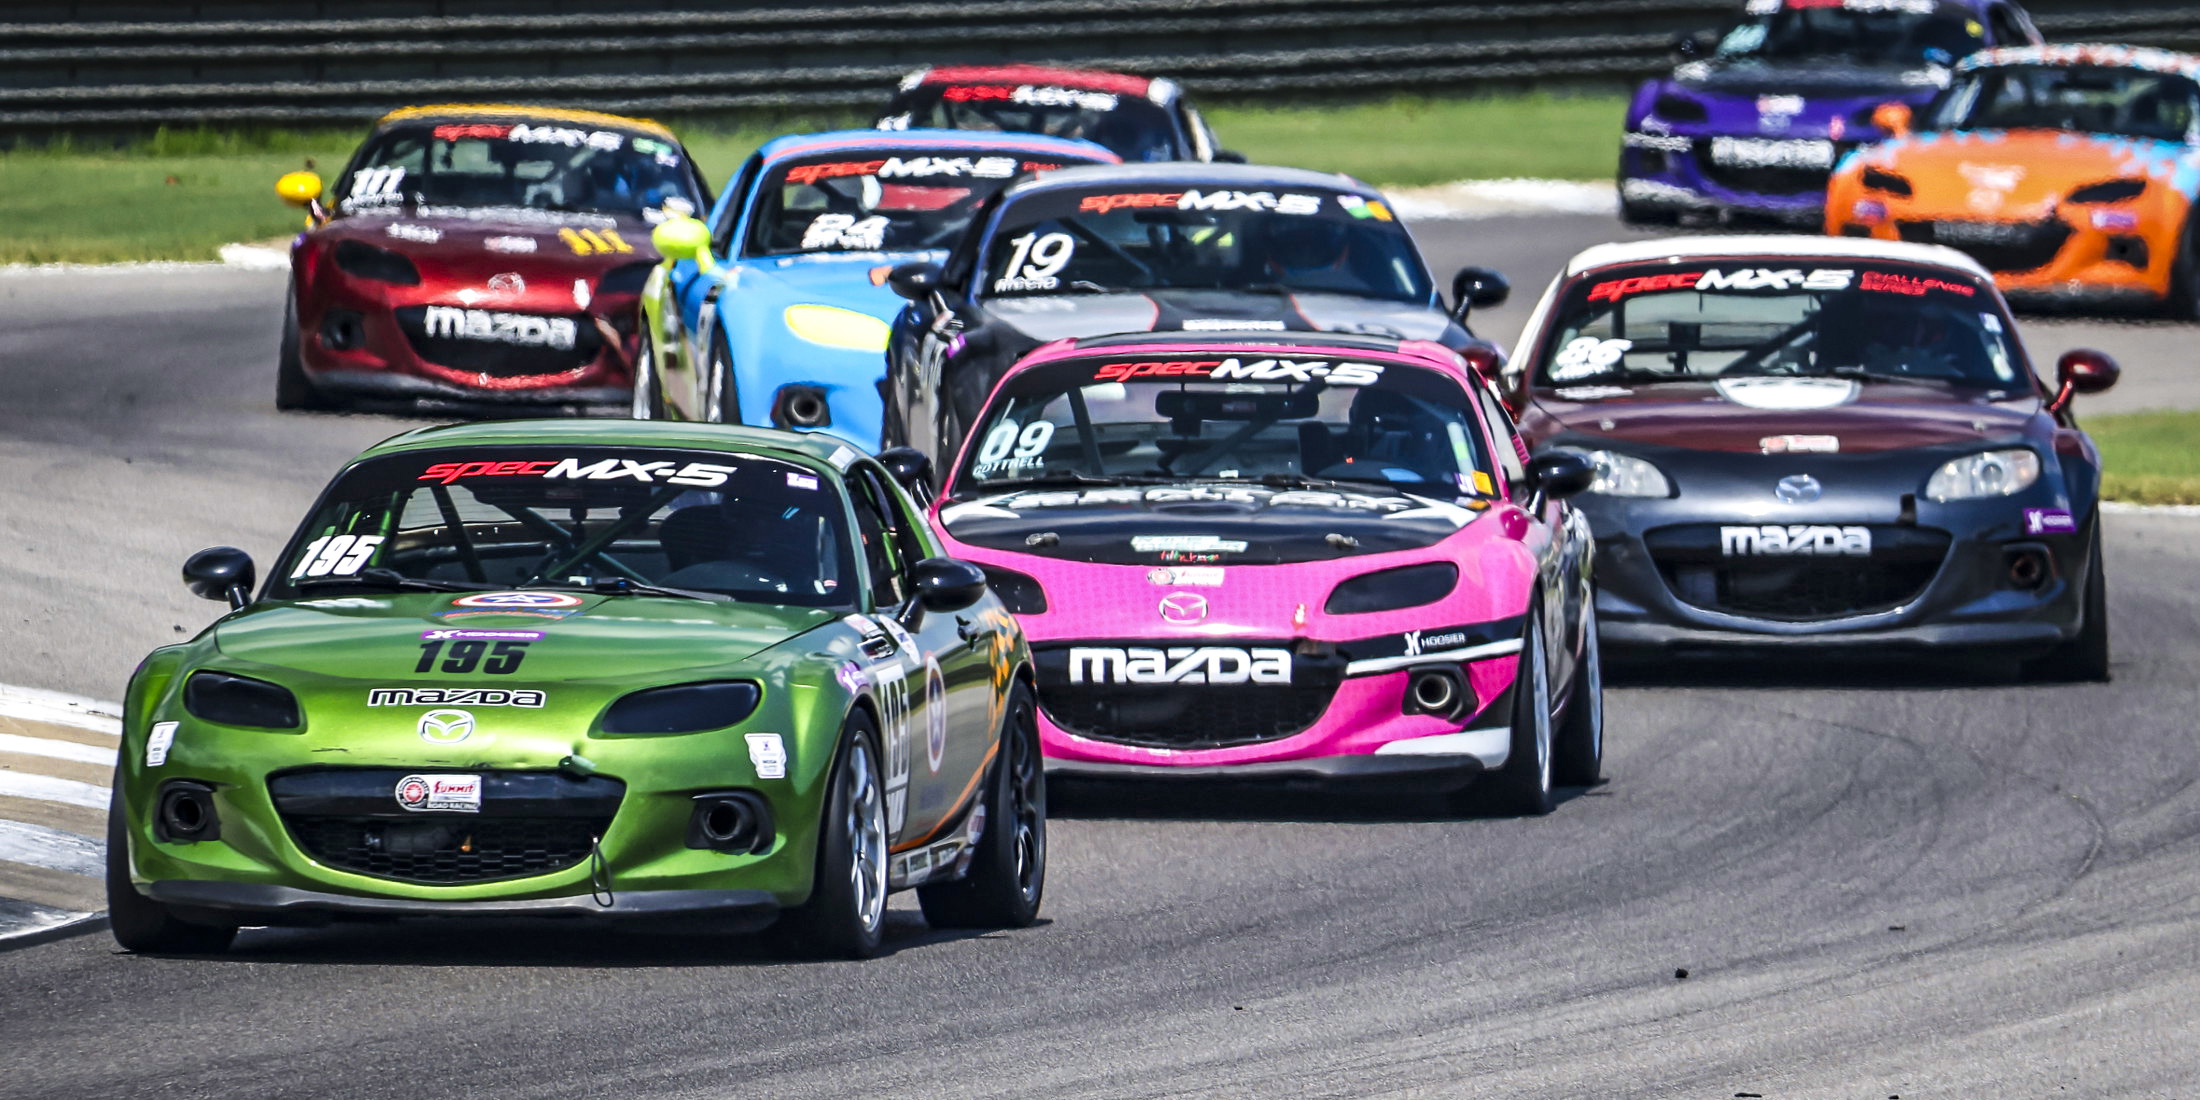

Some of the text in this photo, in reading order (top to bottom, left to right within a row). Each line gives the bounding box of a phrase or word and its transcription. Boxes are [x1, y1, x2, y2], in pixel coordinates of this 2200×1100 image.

[1004, 231, 1075, 279] 19
[1556, 336, 1633, 366] 86
[980, 418, 1055, 463] 09
[290, 534, 386, 579] 195
[414, 640, 531, 675] 195
[1421, 632, 1466, 648] HOOSIER
